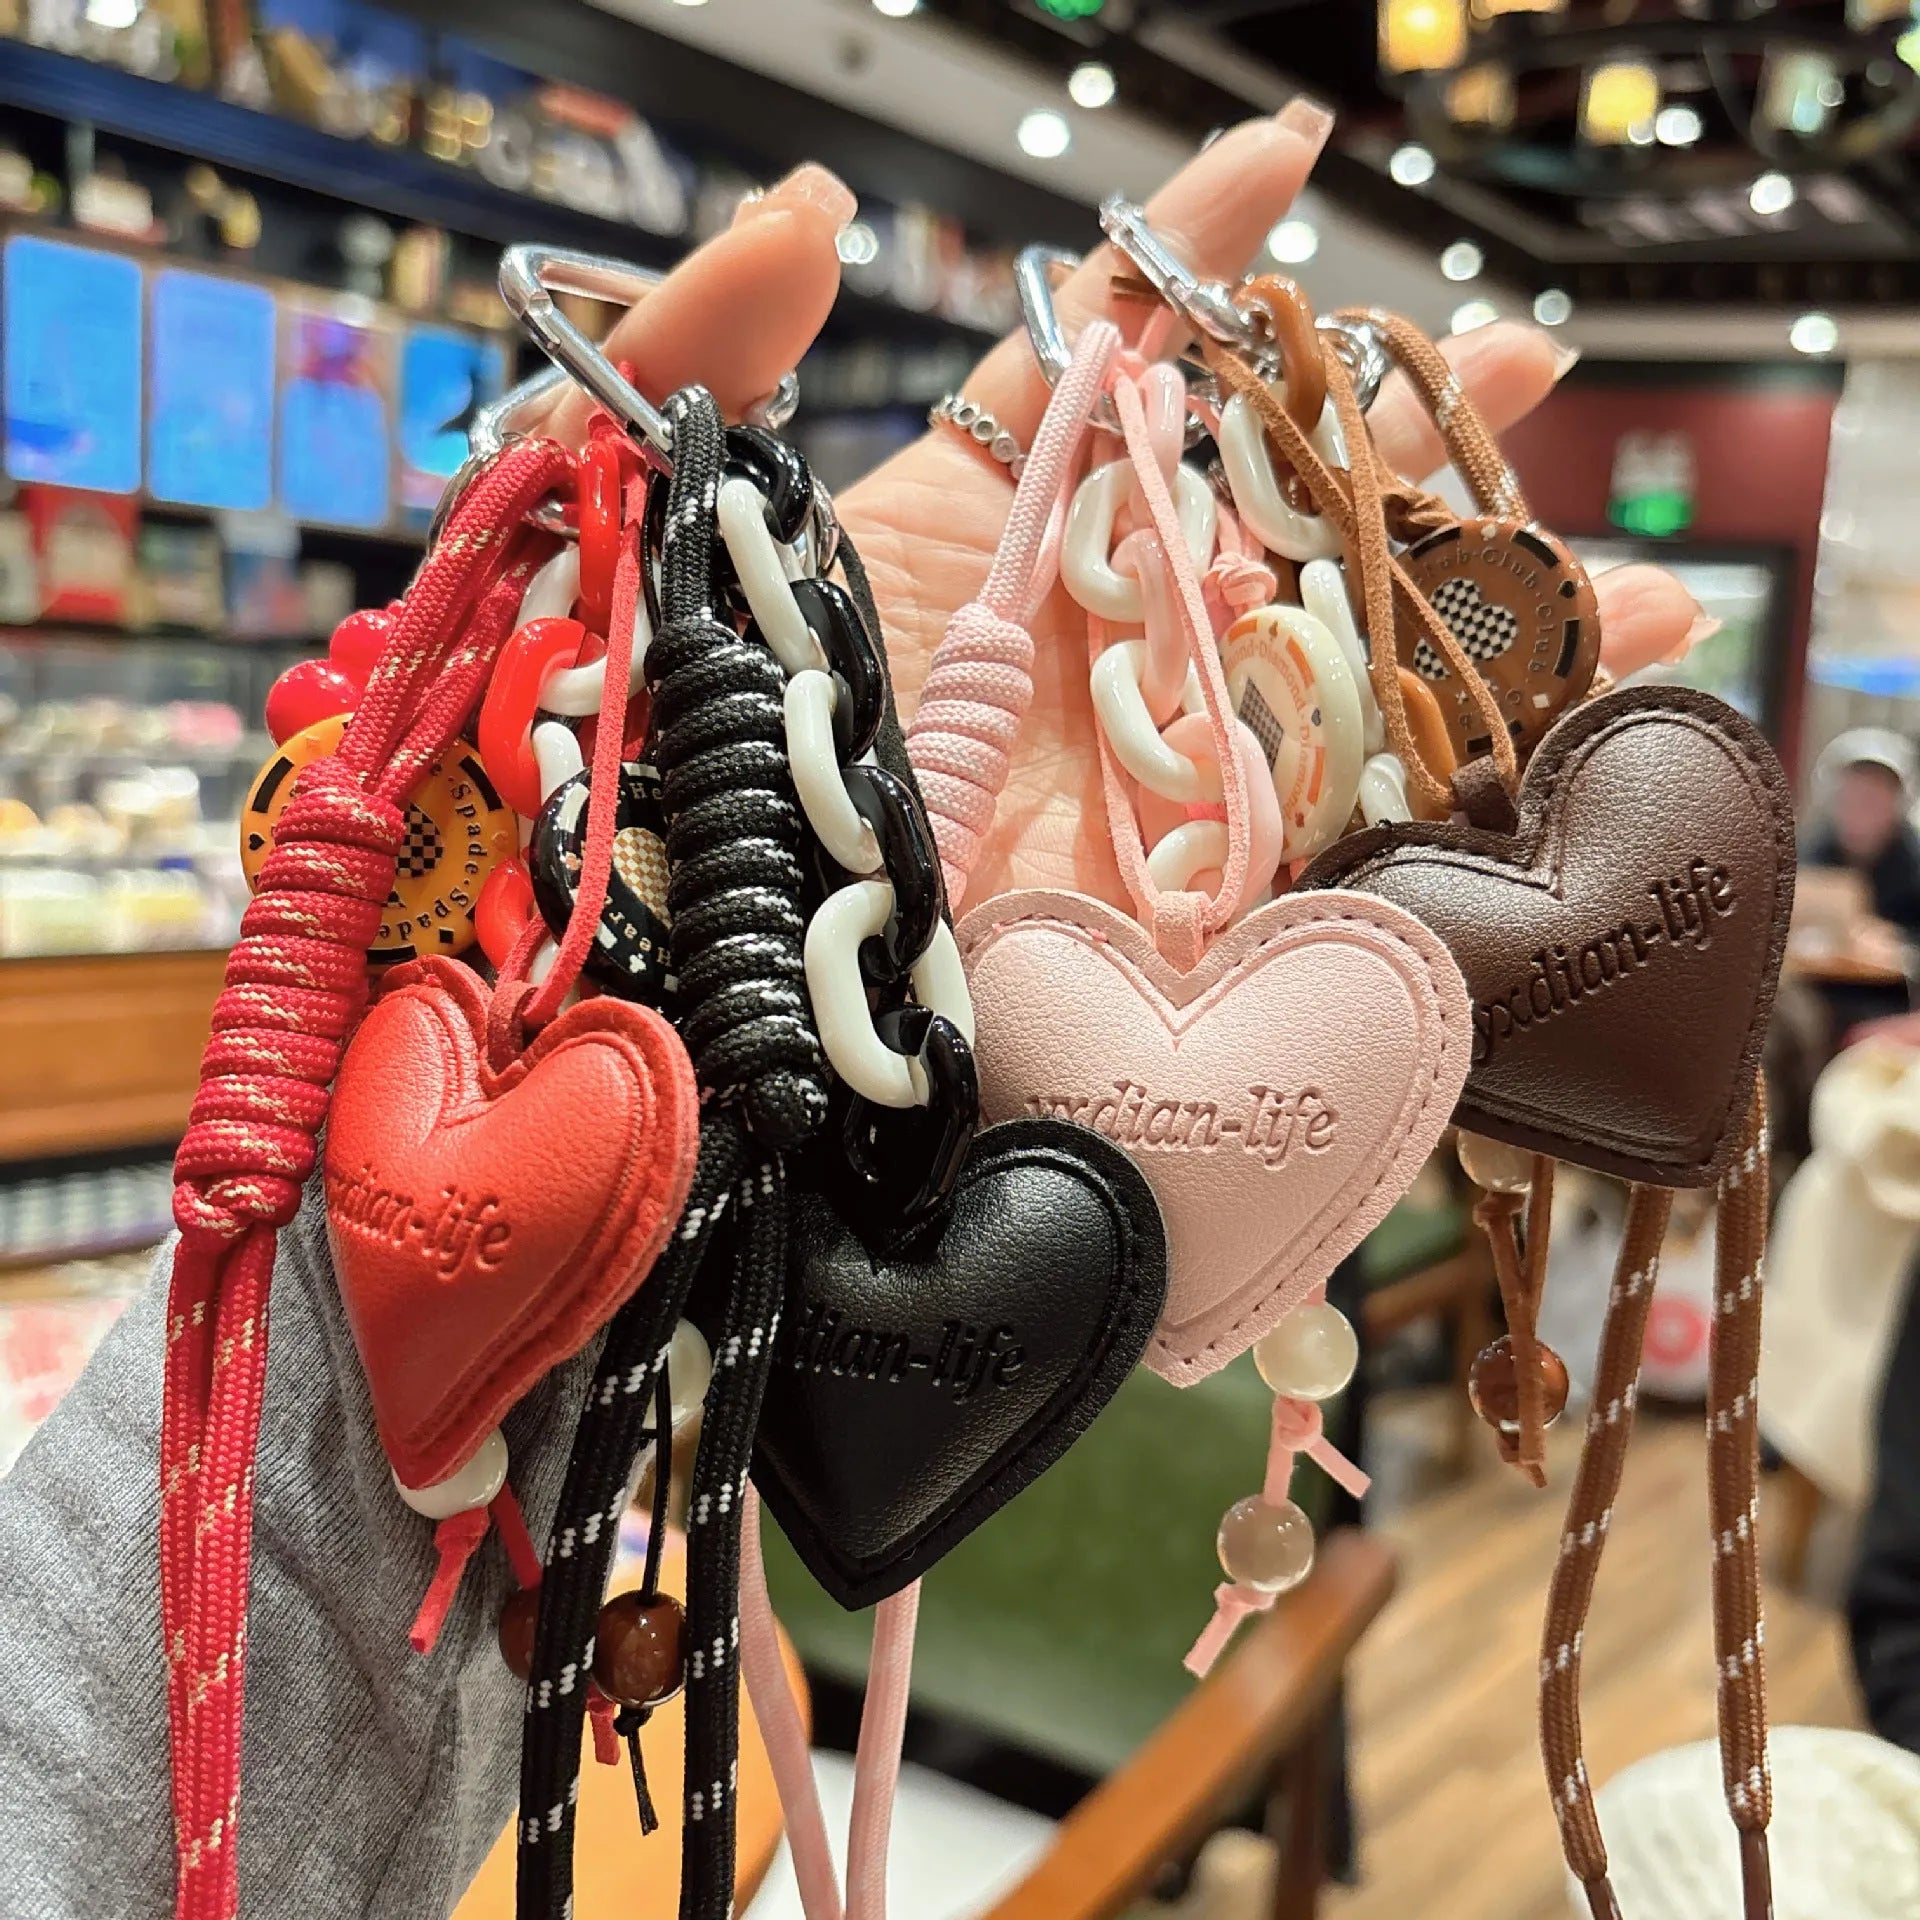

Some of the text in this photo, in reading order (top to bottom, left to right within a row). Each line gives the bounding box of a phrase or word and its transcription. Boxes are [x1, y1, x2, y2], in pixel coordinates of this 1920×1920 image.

[1481, 547, 1537, 591] Club
[1259, 639, 1307, 713] Diamond
[379, 783, 488, 940] Spade Spade
